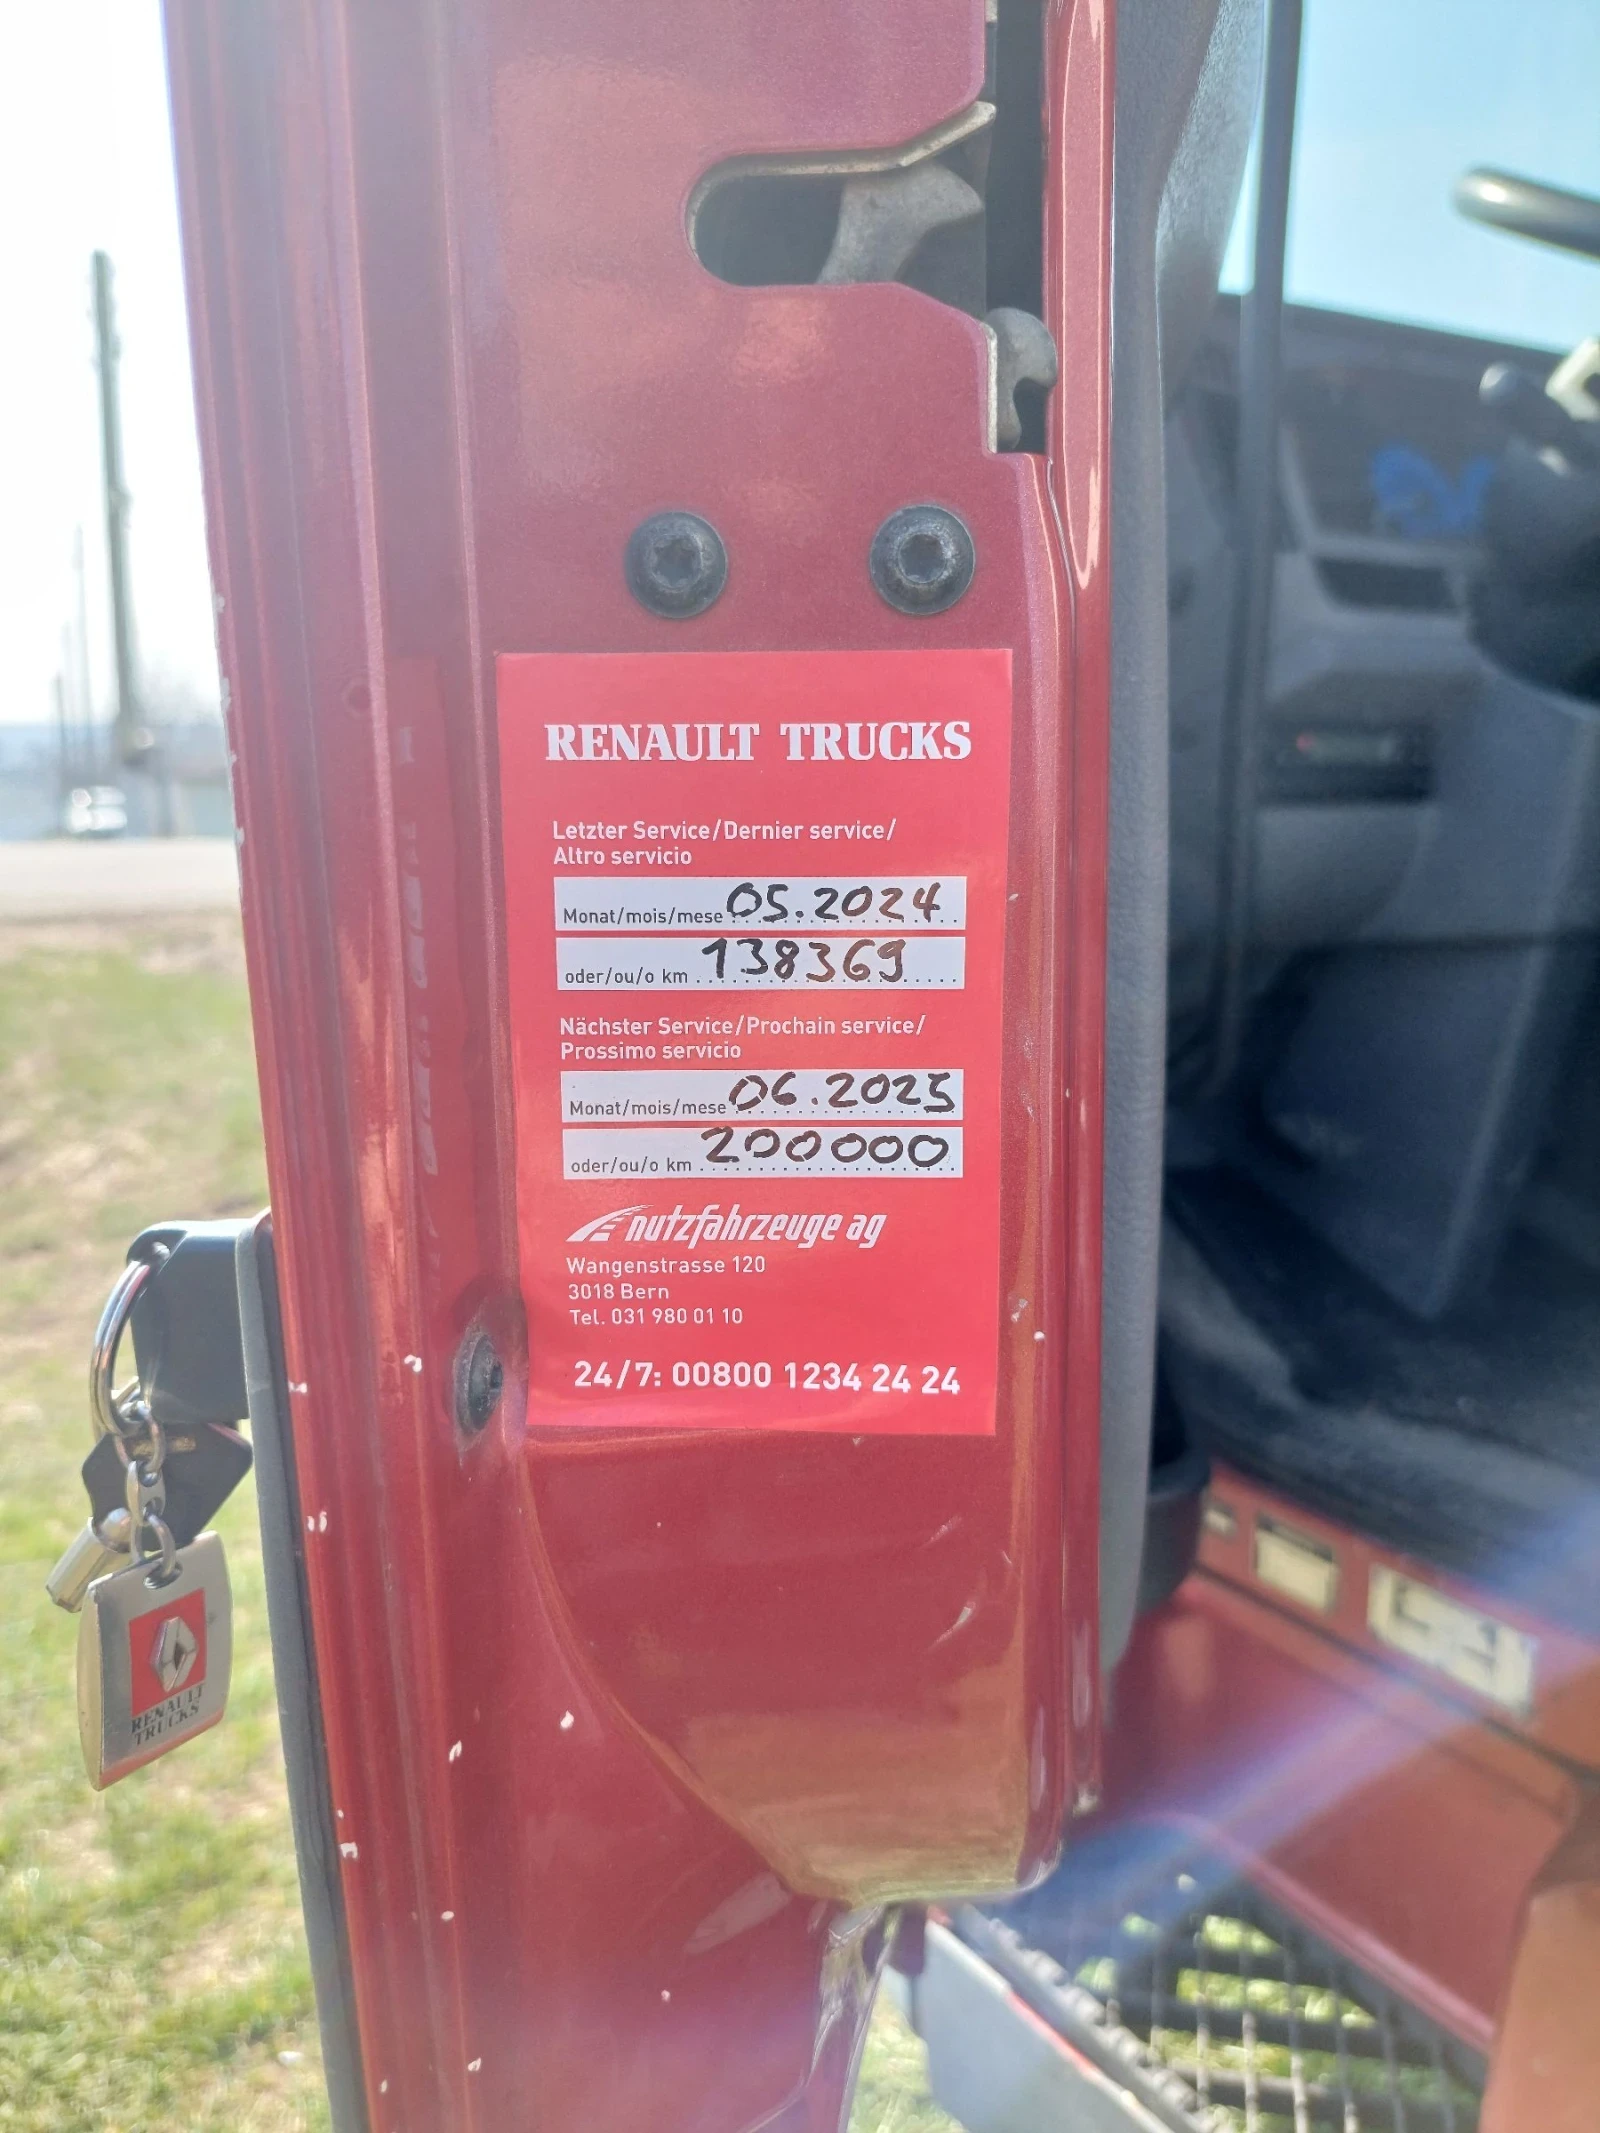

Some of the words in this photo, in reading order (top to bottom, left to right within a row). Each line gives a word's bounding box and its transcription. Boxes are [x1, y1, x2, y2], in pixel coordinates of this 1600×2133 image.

[544, 723, 760, 761] RENAULT
[780, 721, 972, 761] TRUCKS
[552, 821, 627, 841] Letzter
[633, 820, 803, 841] Service/Dernier
[809, 819, 897, 840] service/
[553, 848, 605, 865] Altro
[611, 847, 692, 865] servicio
[726, 881, 941, 923] 05.2024
[563, 907, 723, 925] Monat/mois/mese
[701, 938, 906, 983] 138369
[565, 968, 655, 985] oder/ou/o
[662, 968, 688, 984] km
[560, 1016, 653, 1036] Nächster
[658, 1016, 836, 1036] Service/Prochain
[841, 1015, 926, 1035] service/
[561, 1042, 657, 1060] Prossimo
[662, 1042, 741, 1060] servicio
[729, 1071, 955, 1113] 06.2025
[569, 1099, 727, 1117] Monat/mois/mese
[700, 1126, 949, 1168] 200000
[571, 1157, 660, 1174] oder/ou/o
[667, 1157, 692, 1173] km
[625, 1204, 842, 1249] nutzfahrzeuge
[846, 1214, 887, 1248] ag
[567, 1257, 726, 1277] Wangenstrasse
[733, 1256, 766, 1273] 120
[568, 1284, 614, 1300] 3018
[620, 1284, 669, 1300] Bern
[570, 1309, 605, 1326] Tel.
[611, 1309, 645, 1325] 031
[651, 1308, 687, 1325] 980
[692, 1308, 714, 1325] 01
[722, 1308, 743, 1325] 10
[574, 1360, 662, 1389] 24/7:
[672, 1362, 772, 1389] 00800
[784, 1363, 861, 1391] 1234
[872, 1364, 911, 1393] 24
[921, 1365, 961, 1395] 24
